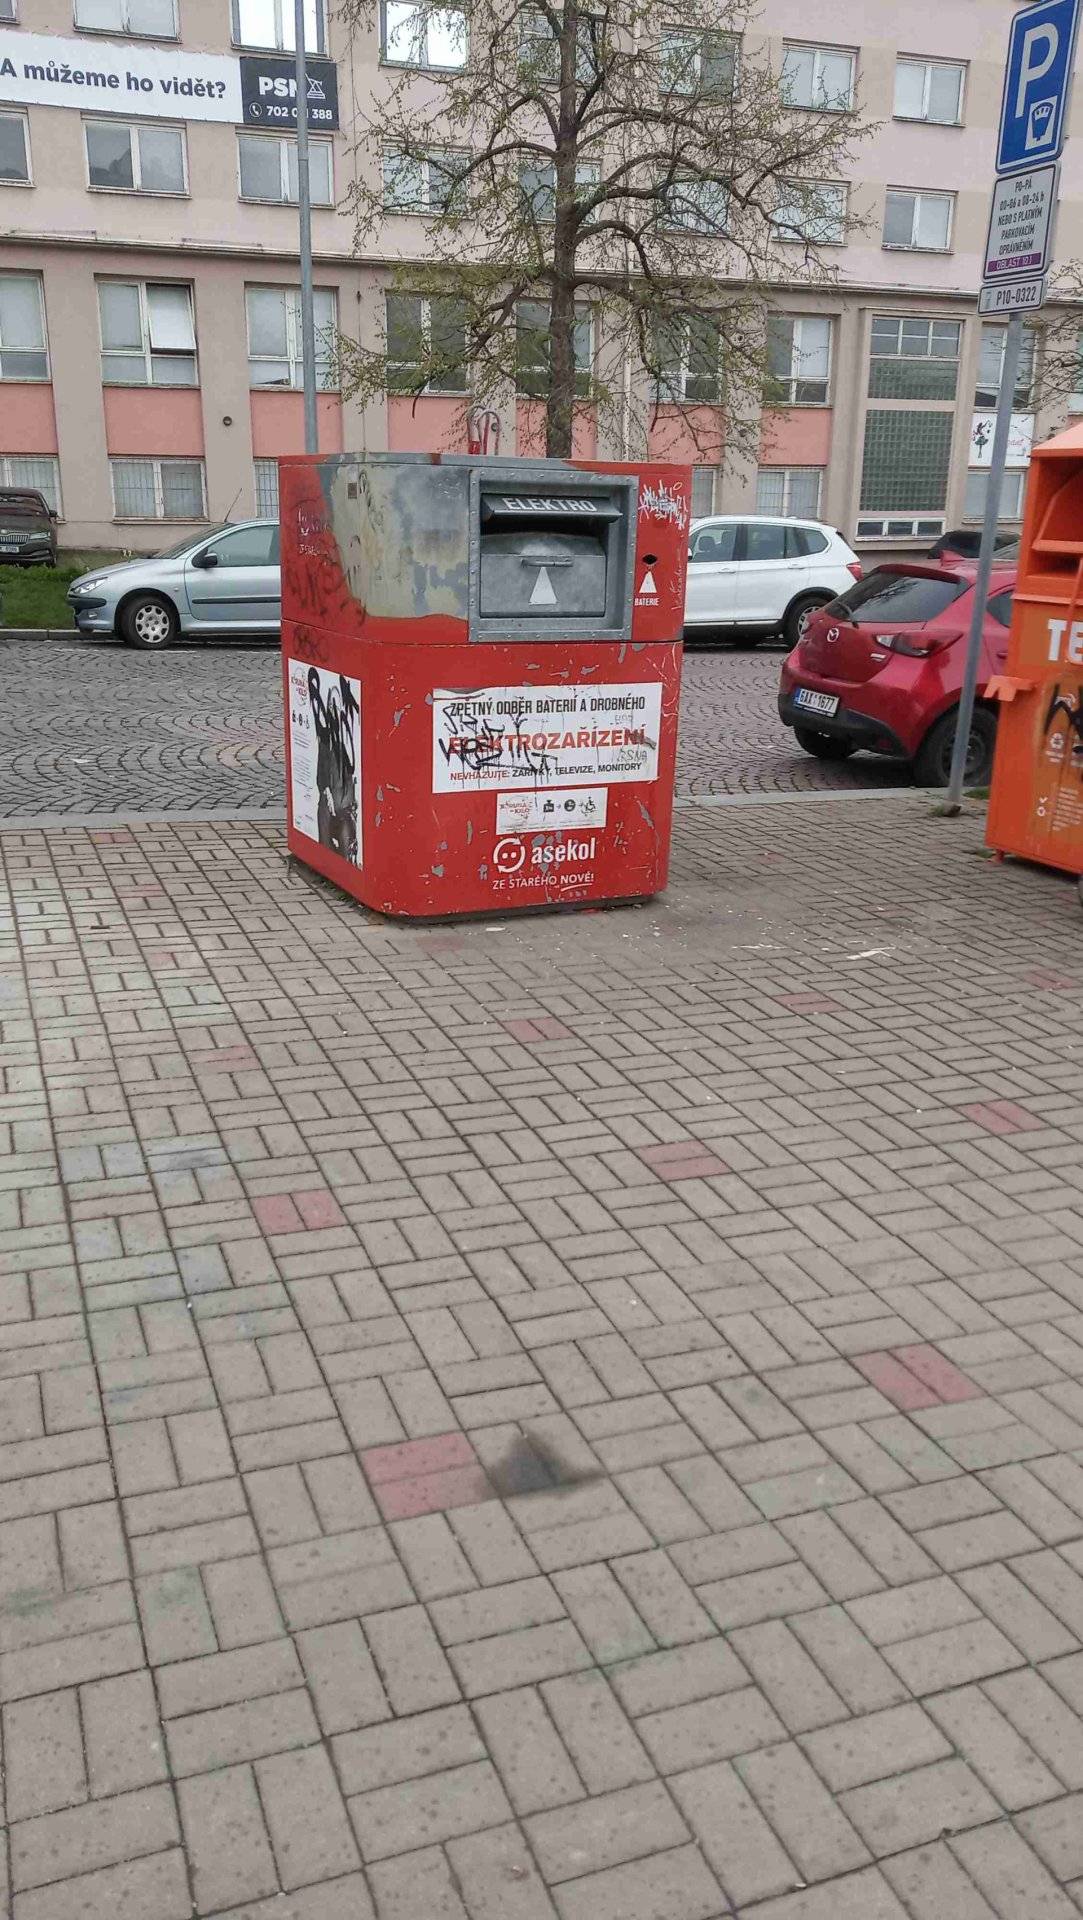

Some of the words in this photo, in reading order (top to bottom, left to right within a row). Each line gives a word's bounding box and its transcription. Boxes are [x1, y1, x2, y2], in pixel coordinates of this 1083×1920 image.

[0, 58, 17, 78] A
[24, 60, 120, 89] můžeme
[126, 71, 153, 92] ho
[159, 76, 226, 99] vidět?
[1015, 22, 1059, 119] P
[266, 105, 288, 117] 702
[291, 107, 309, 118] 01
[311, 108, 333, 120] 388
[998, 212, 1012, 226] NEBO
[1017, 205, 1043, 222] PLATNÝM
[1001, 222, 1035, 240] PARKOVACÍM
[996, 257, 1020, 270] OBLAST
[996, 286, 1037, 306] P10-0322
[502, 497, 598, 512] ELEKTRO
[634, 597, 660, 606] BATERIE
[450, 697, 492, 716] ZPĚTNÝ
[496, 696, 532, 715] ODBĚR
[536, 694, 578, 713] BATERIÍ
[580, 699, 587, 711] A
[591, 692, 645, 711] DROBNÉHO
[450, 769, 510, 781] NEVHAZUJTE:
[555, 765, 595, 776] TELEVIZE,
[598, 762, 642, 773] MONITORY
[531, 838, 596, 864] asekol
[493, 879, 505, 890] ZE
[509, 874, 557, 888] STARÉHO
[560, 870, 594, 885] NOVÉ!
